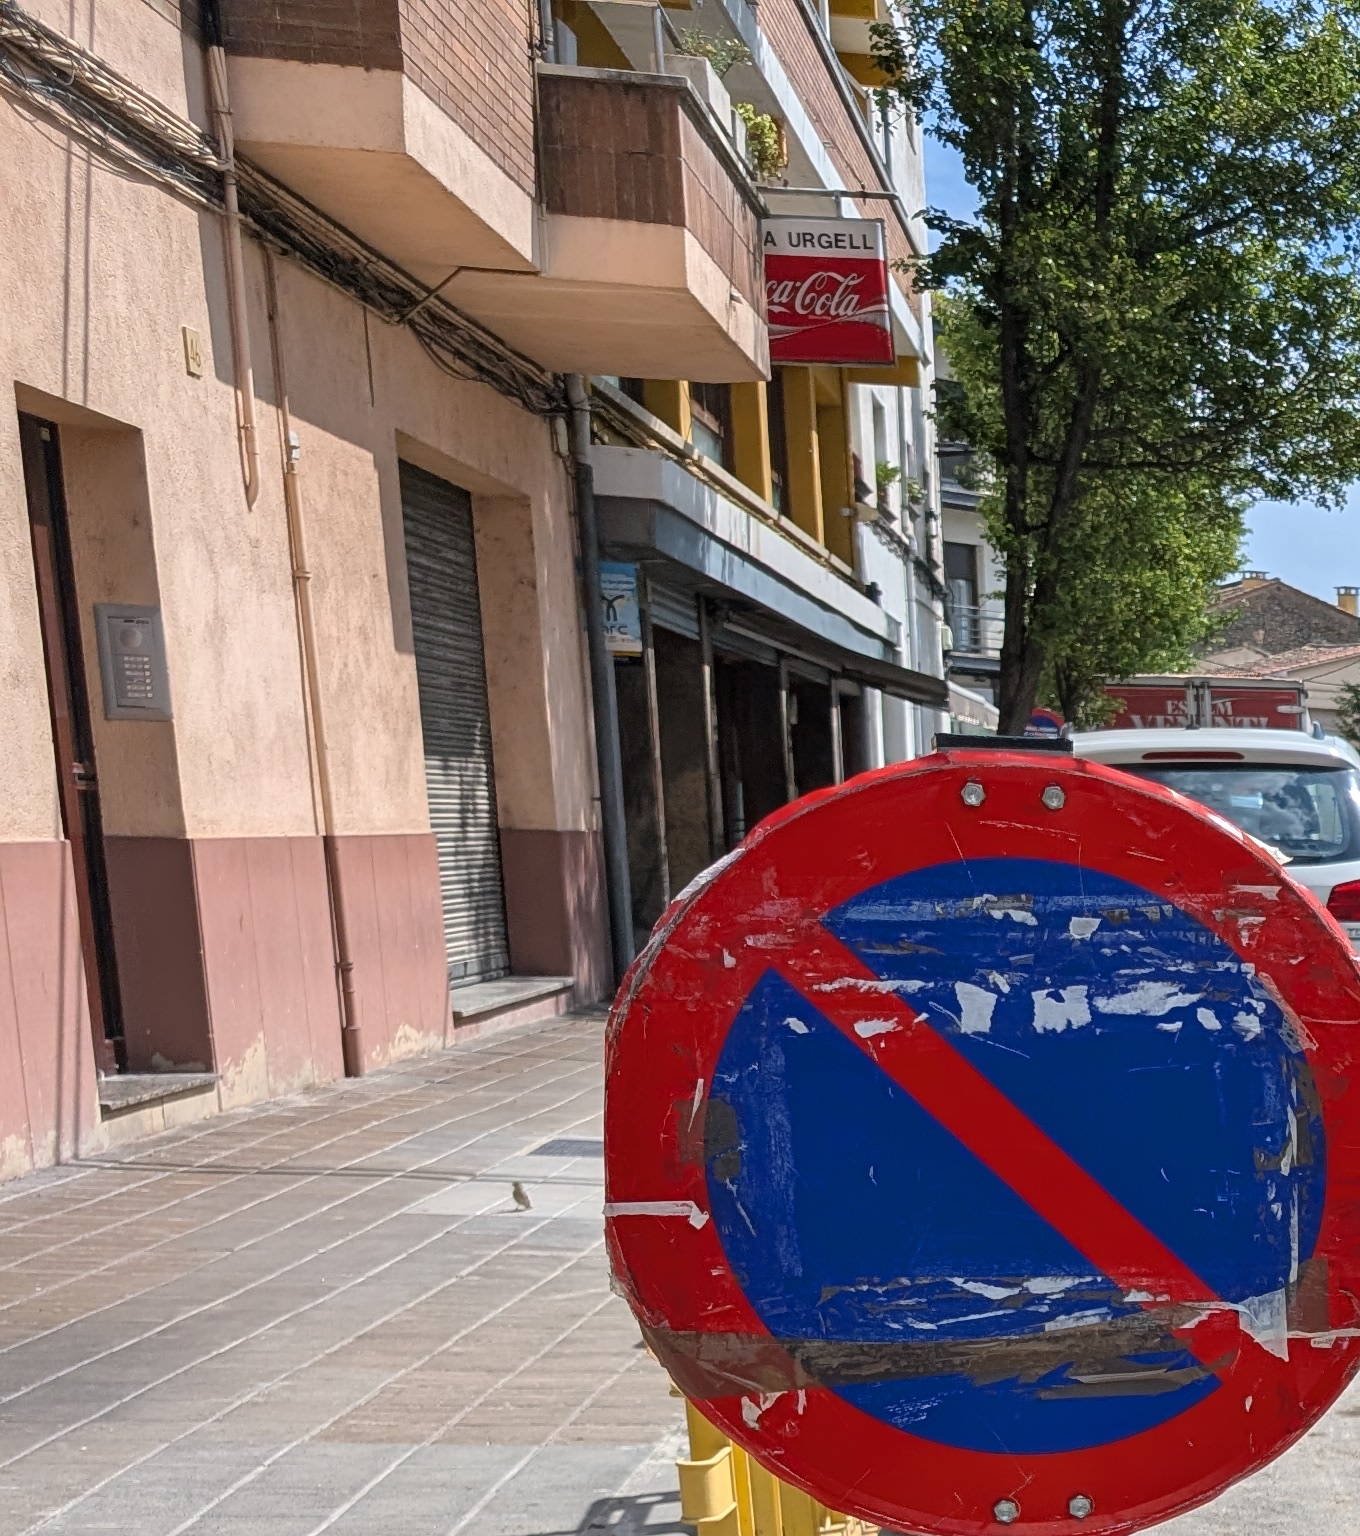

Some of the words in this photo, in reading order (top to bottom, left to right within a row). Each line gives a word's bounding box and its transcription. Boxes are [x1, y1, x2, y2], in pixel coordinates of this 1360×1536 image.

[764, 231, 777, 247] A
[788, 232, 875, 250] URGELL
[766, 271, 866, 317] ca-Cola
[190, 338, 201, 367] 46
